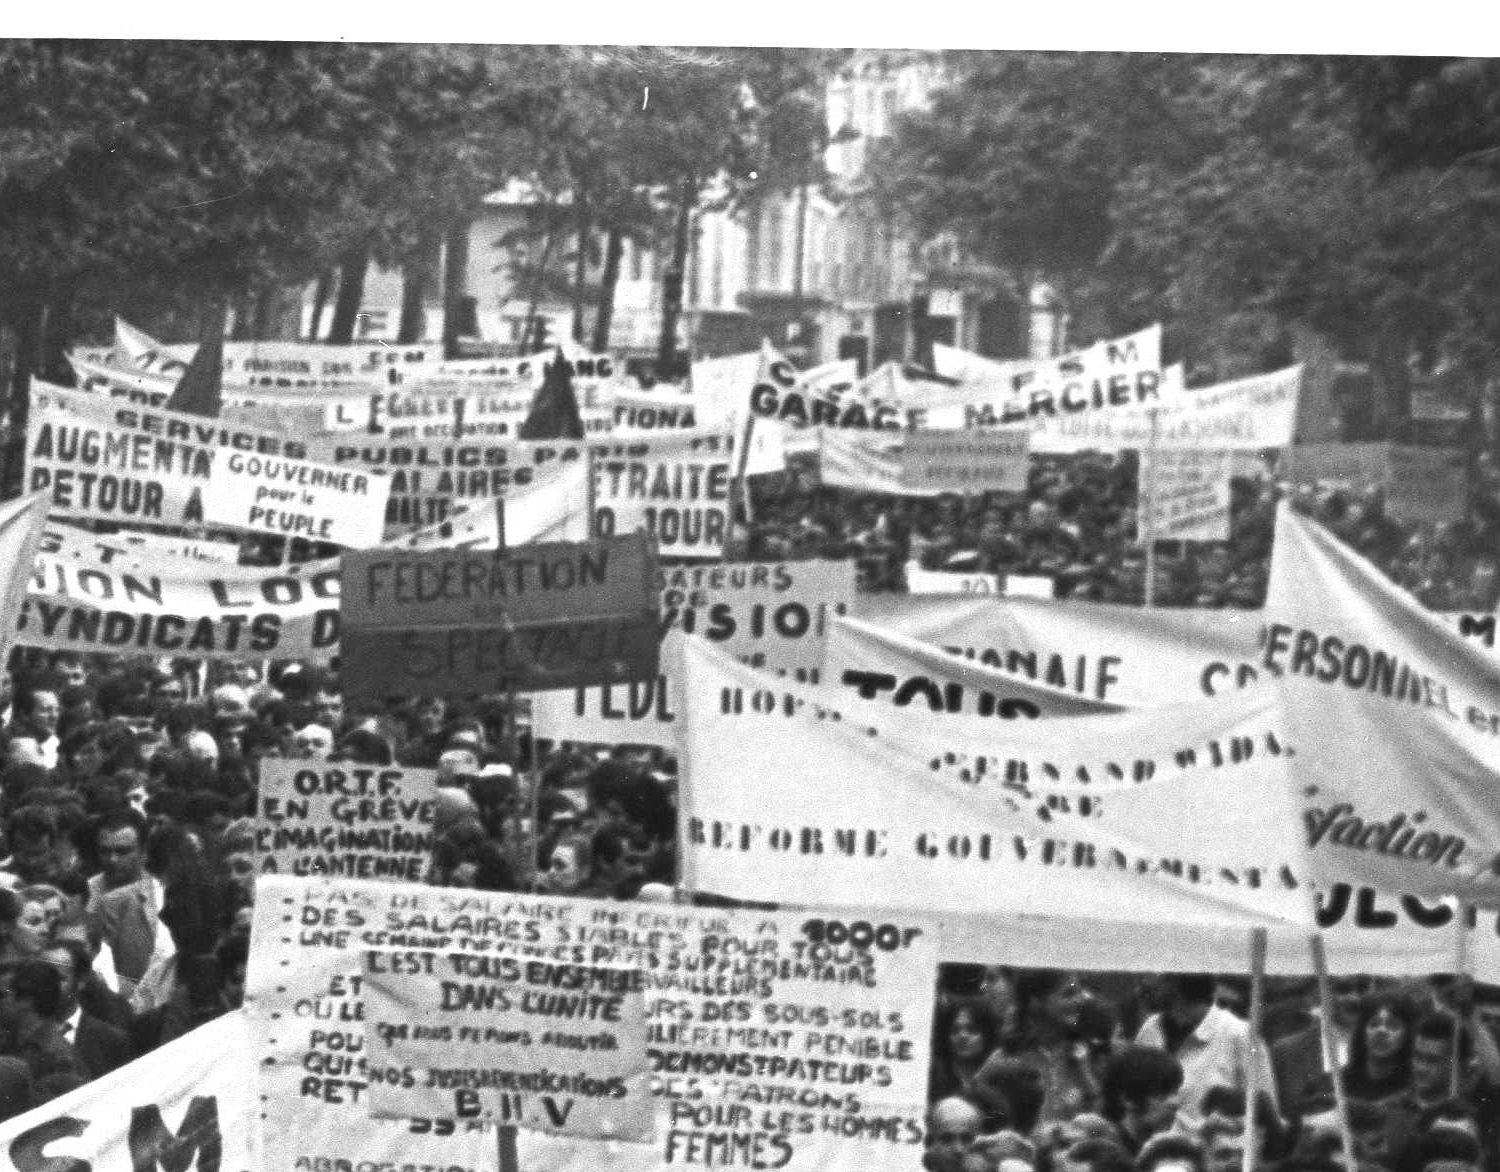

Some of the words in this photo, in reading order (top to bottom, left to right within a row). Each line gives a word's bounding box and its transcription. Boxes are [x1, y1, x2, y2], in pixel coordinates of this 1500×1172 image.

[228, 453, 369, 496] GOUVERNER
[250, 505, 335, 539] PEUPLE
[365, 549, 609, 608] FEDERATION
[1259, 623, 1457, 720] ERSONNEL
[262, 798, 309, 821] EN
[298, 930, 352, 949] UNE
[299, 904, 366, 928] DES
[384, 910, 542, 943] SALAIRES
[701, 934, 778, 959] POUR
[446, 953, 522, 983] TOUS
[701, 1000, 752, 1022] DES
[762, 1002, 904, 1034] SOUS-SOLS
[368, 1066, 415, 1088] NOS
[670, 1100, 752, 1128] POUR
[761, 1110, 814, 1134] LES
[822, 1113, 925, 1146] HOMMES
[664, 1130, 793, 1170] FEMMES
